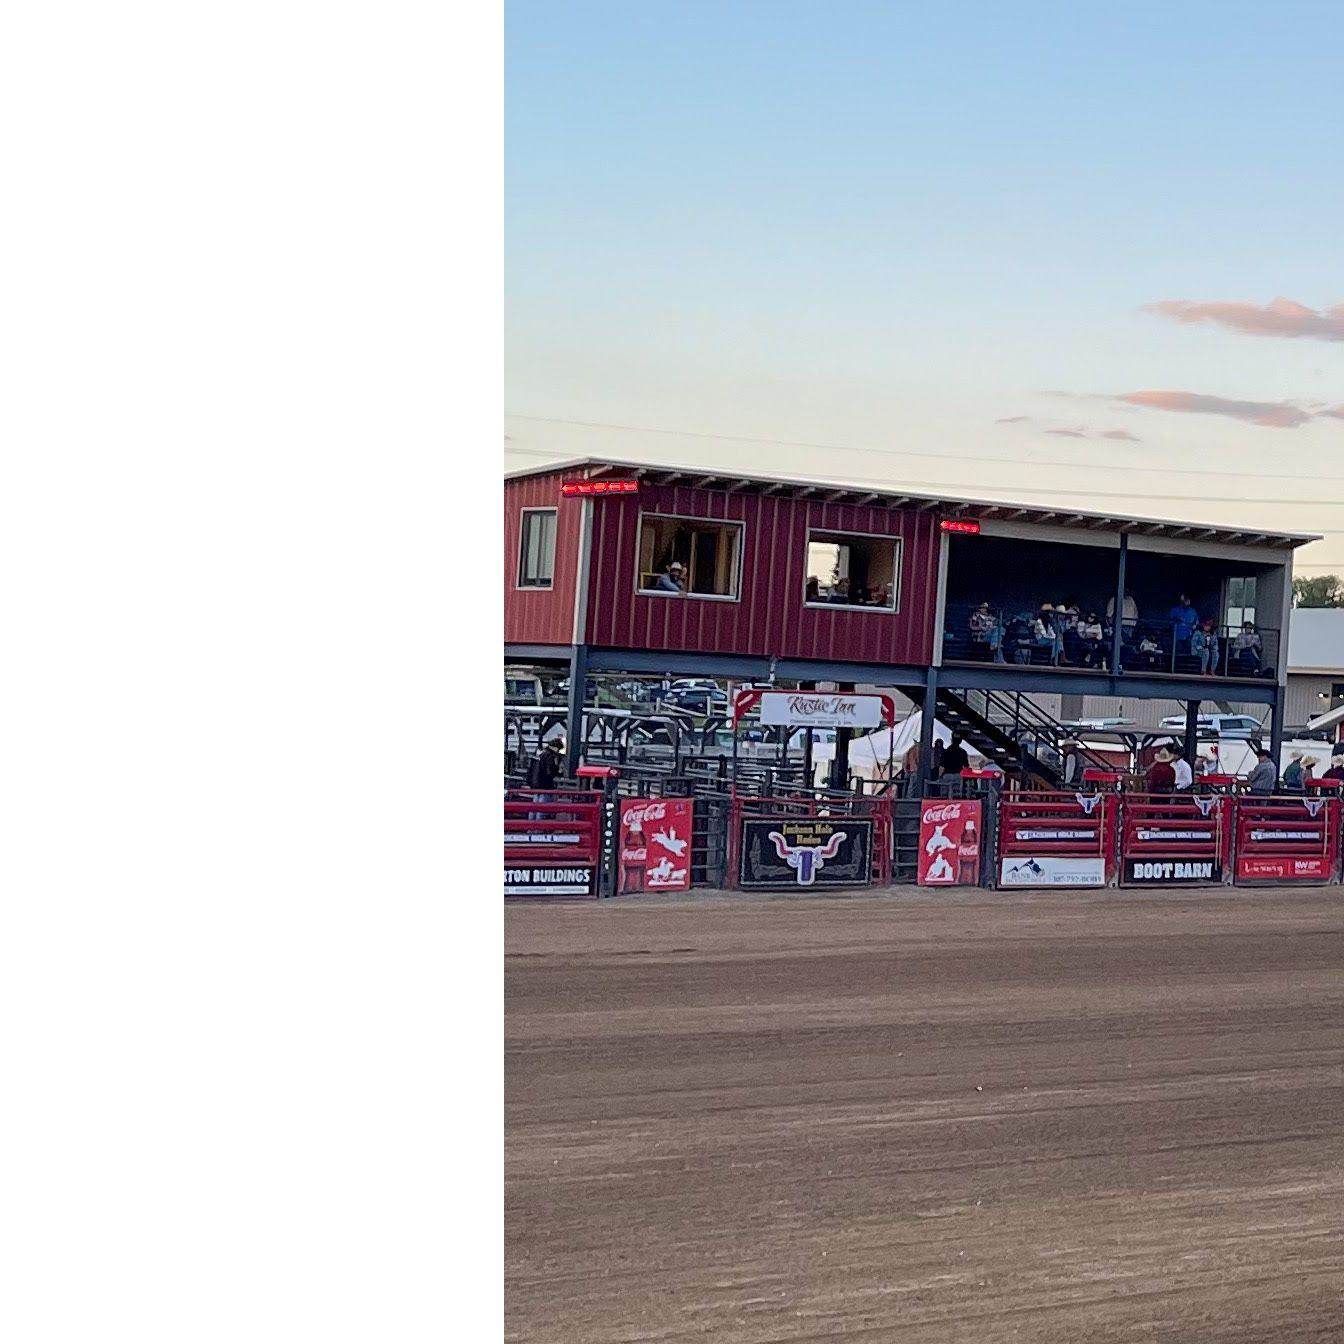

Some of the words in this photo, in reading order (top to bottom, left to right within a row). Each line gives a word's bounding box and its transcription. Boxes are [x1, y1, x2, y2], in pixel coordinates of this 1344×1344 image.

[788, 696, 829, 715] Rustic
[832, 697, 856, 716] Inn
[533, 869, 591, 883] BUILDINGS
[1133, 863, 1173, 878] BOOT
[1174, 863, 1213, 878] BARN
